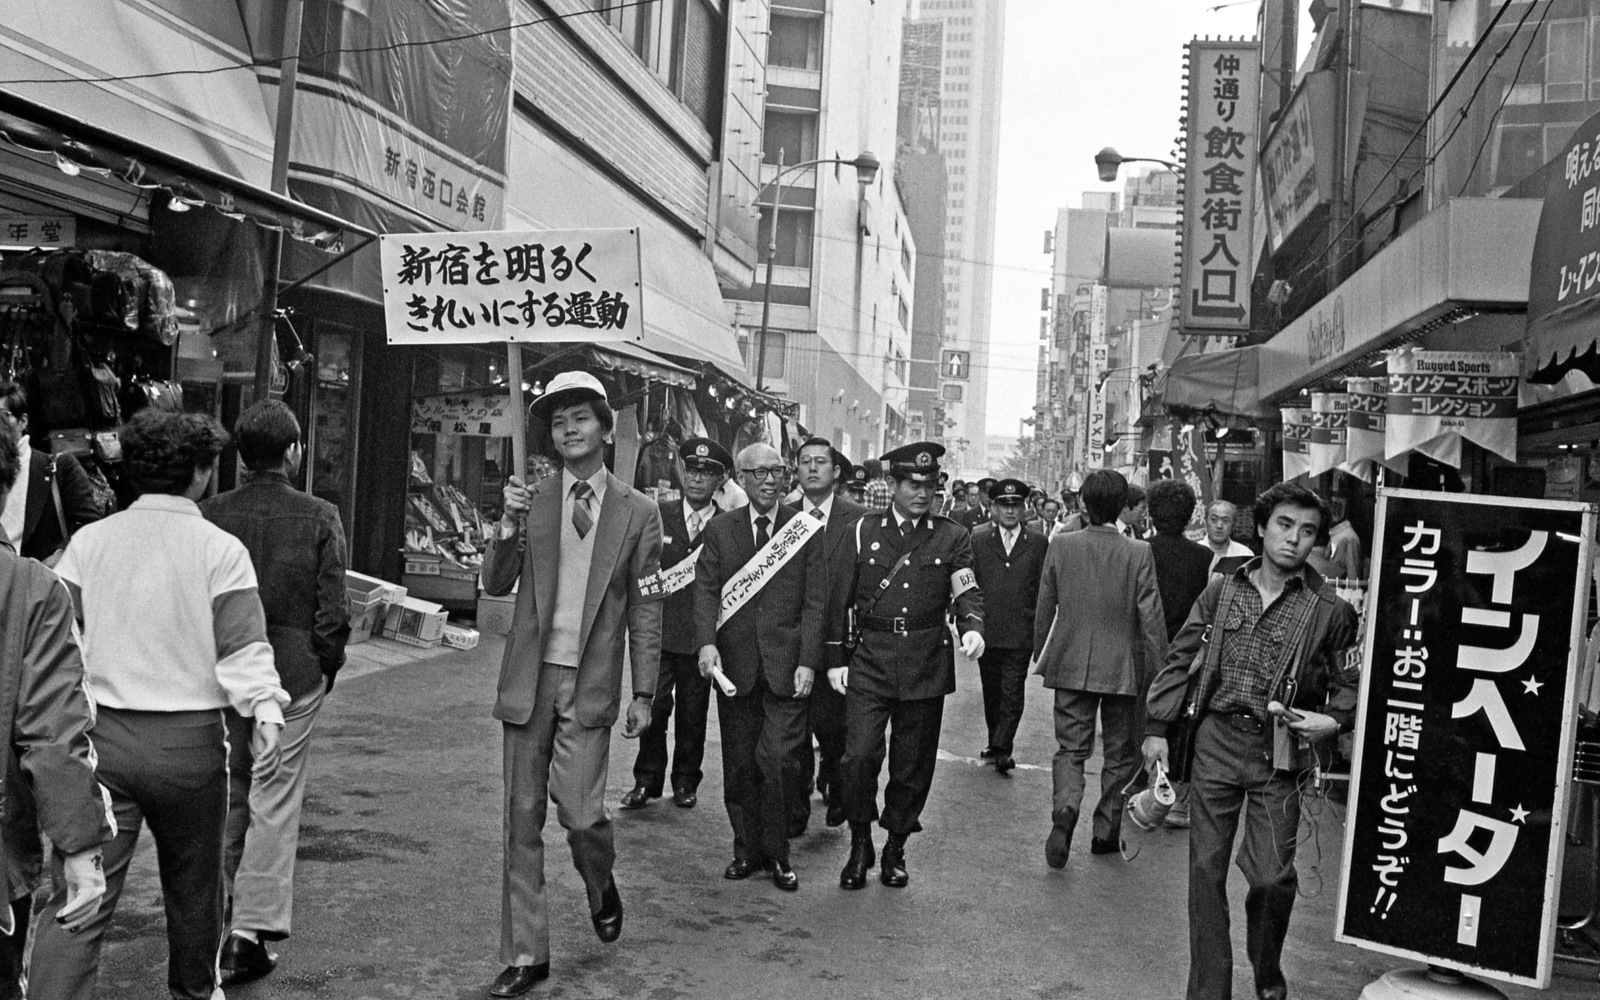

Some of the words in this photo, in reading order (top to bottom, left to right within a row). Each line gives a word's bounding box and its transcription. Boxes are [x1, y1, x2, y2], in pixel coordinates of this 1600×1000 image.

[383, 145, 487, 223] 新宿西口会館
[1200, 53, 1246, 303] 仲通り飲食街入口
[1581, 186, 1600, 233] 同
[397, 241, 597, 285] 新宿を明るく
[406, 289, 630, 333] きれいにする運動
[1417, 360, 1456, 373] Rugged
[1458, 361, 1491, 374] Sports
[1389, 374, 1517, 396] ウインタースポーツ
[1350, 394, 1387, 412] ウイン
[1411, 397, 1496, 417] コレクション
[1312, 412, 1348, 428] ウイン
